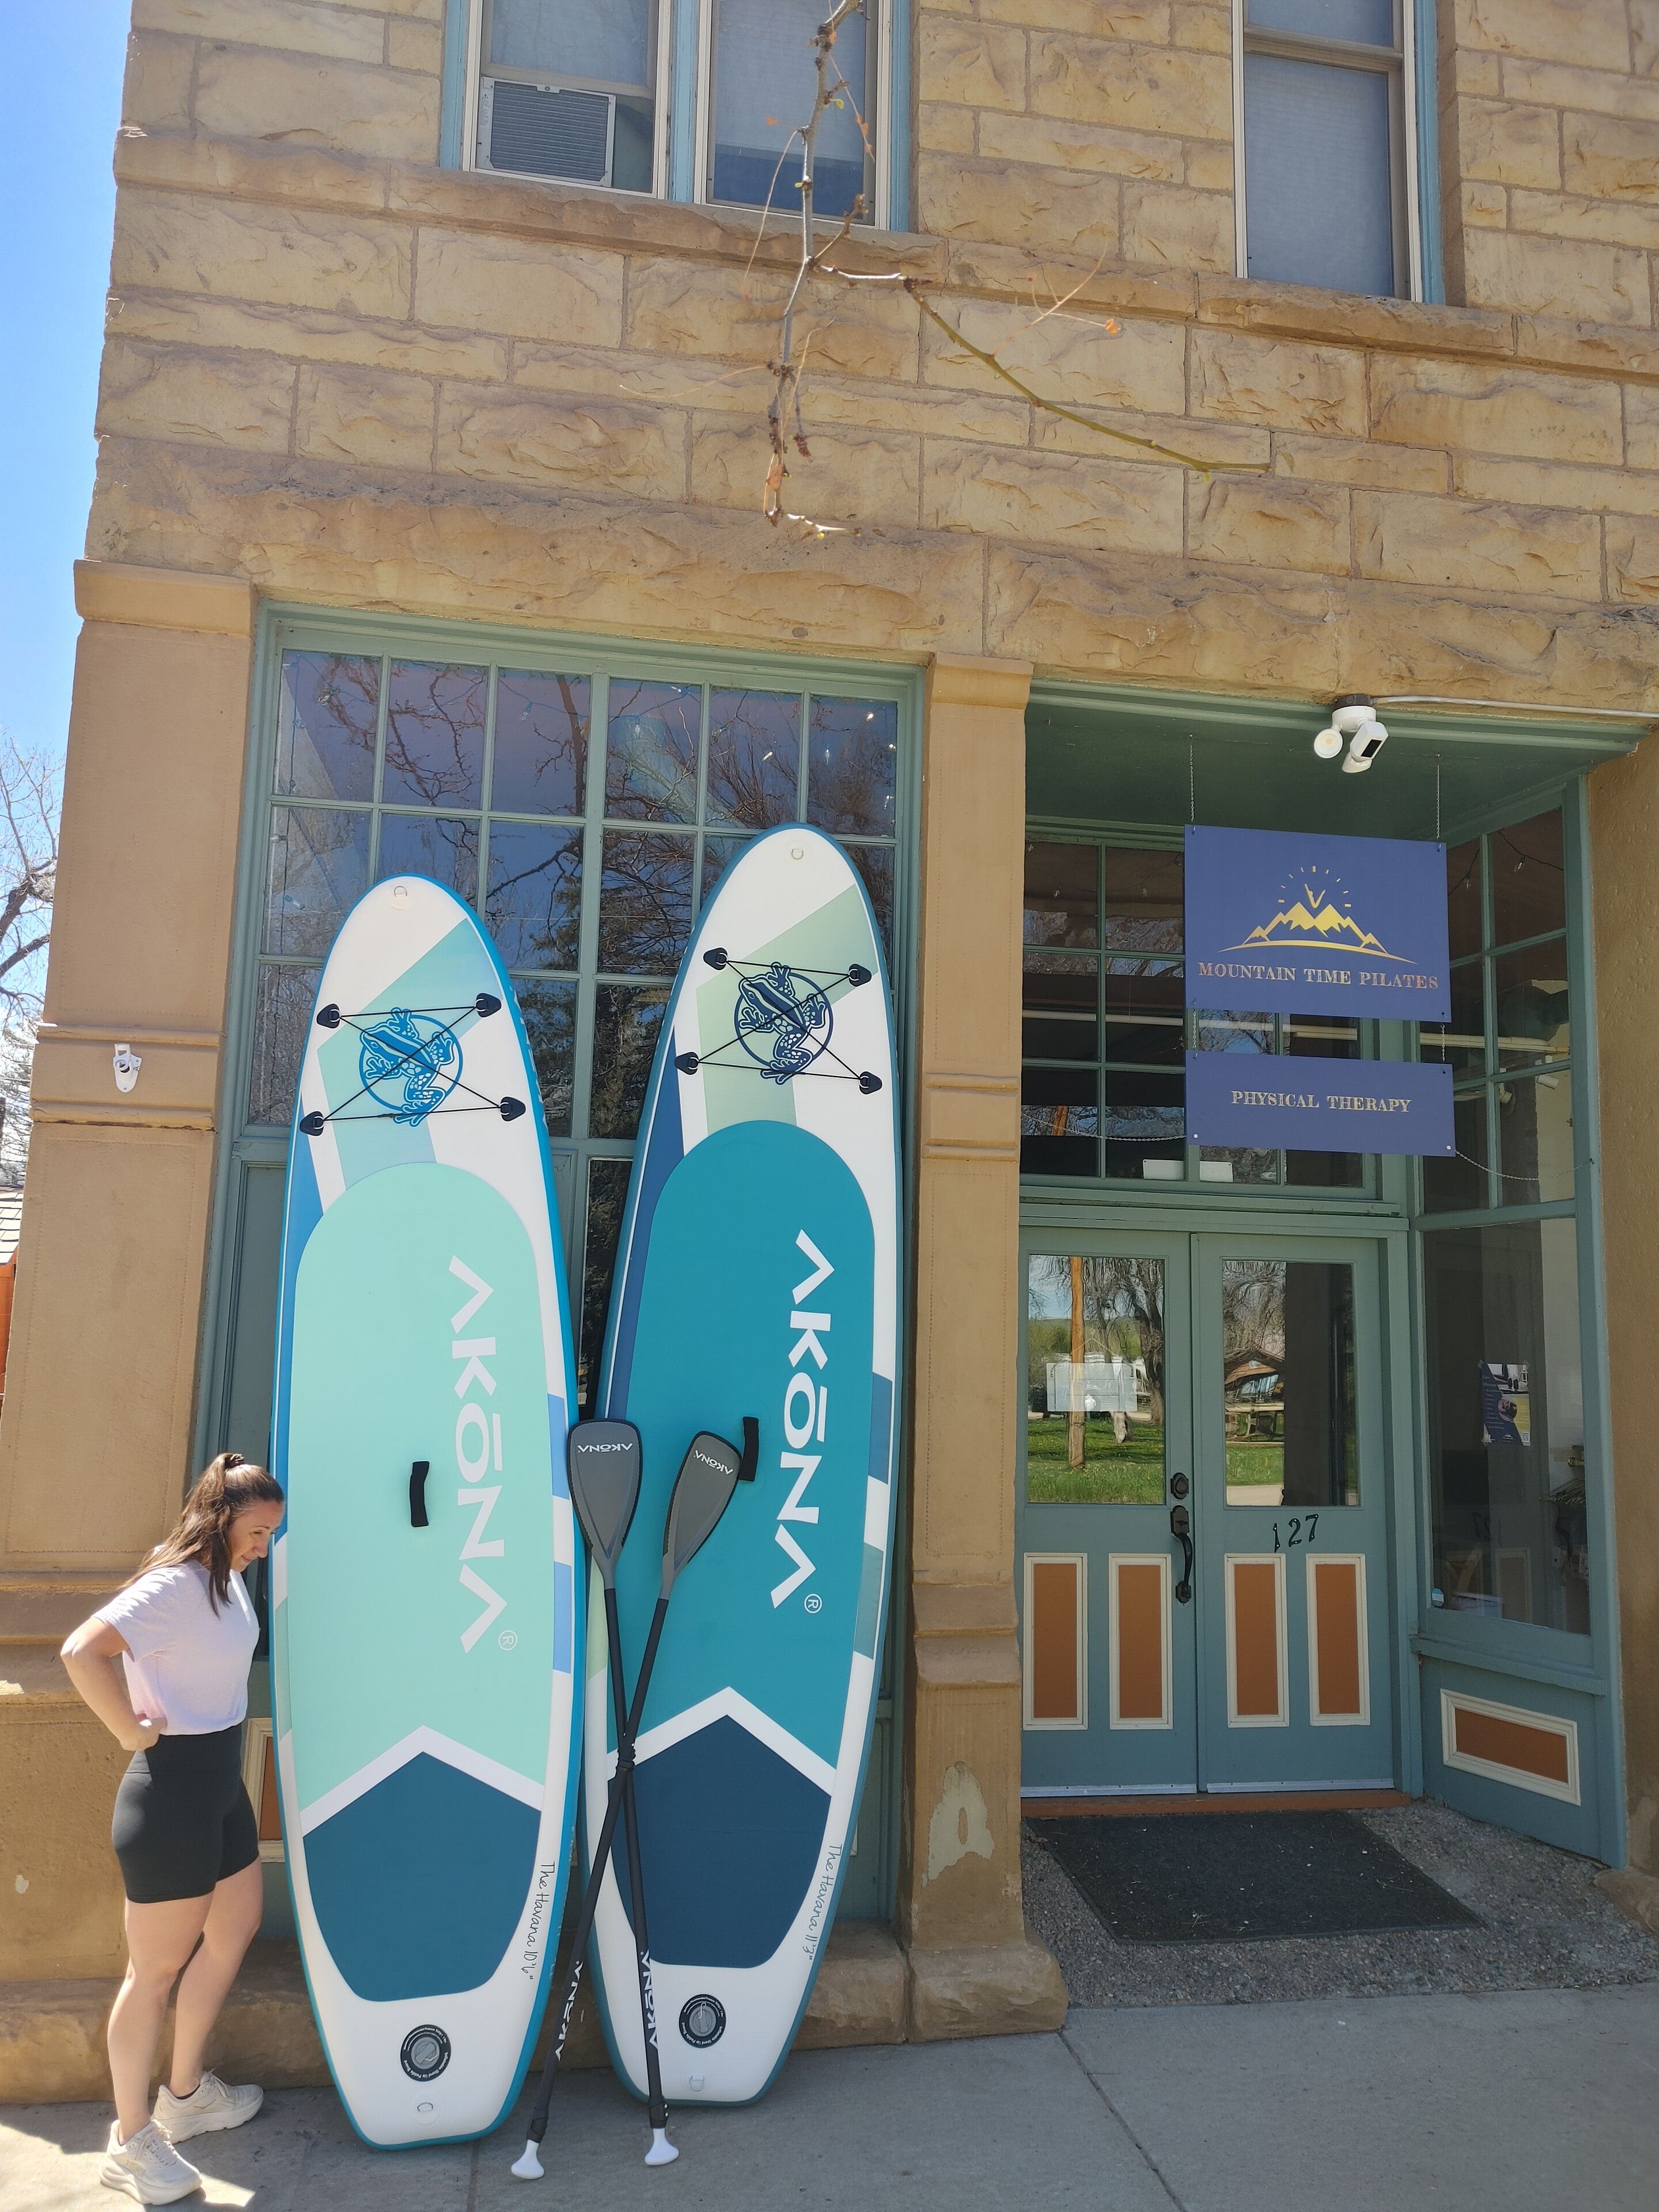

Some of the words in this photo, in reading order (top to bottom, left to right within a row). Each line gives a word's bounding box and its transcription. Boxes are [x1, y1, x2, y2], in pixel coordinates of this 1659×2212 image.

[1199, 961, 1296, 982] MOUNTAIN
[1304, 968, 1351, 985] TIME
[1359, 972, 1438, 990] PILATES
[1230, 1090, 1319, 1108] PHYSICAL
[1327, 1094, 1411, 1113] THERAPY
[1272, 1514, 1319, 1553] 127
[826, 1844, 843, 1872] The
[539, 1862, 555, 1889] The
[809, 1875, 835, 1931] Havana
[527, 1892, 550, 1947] Havana
